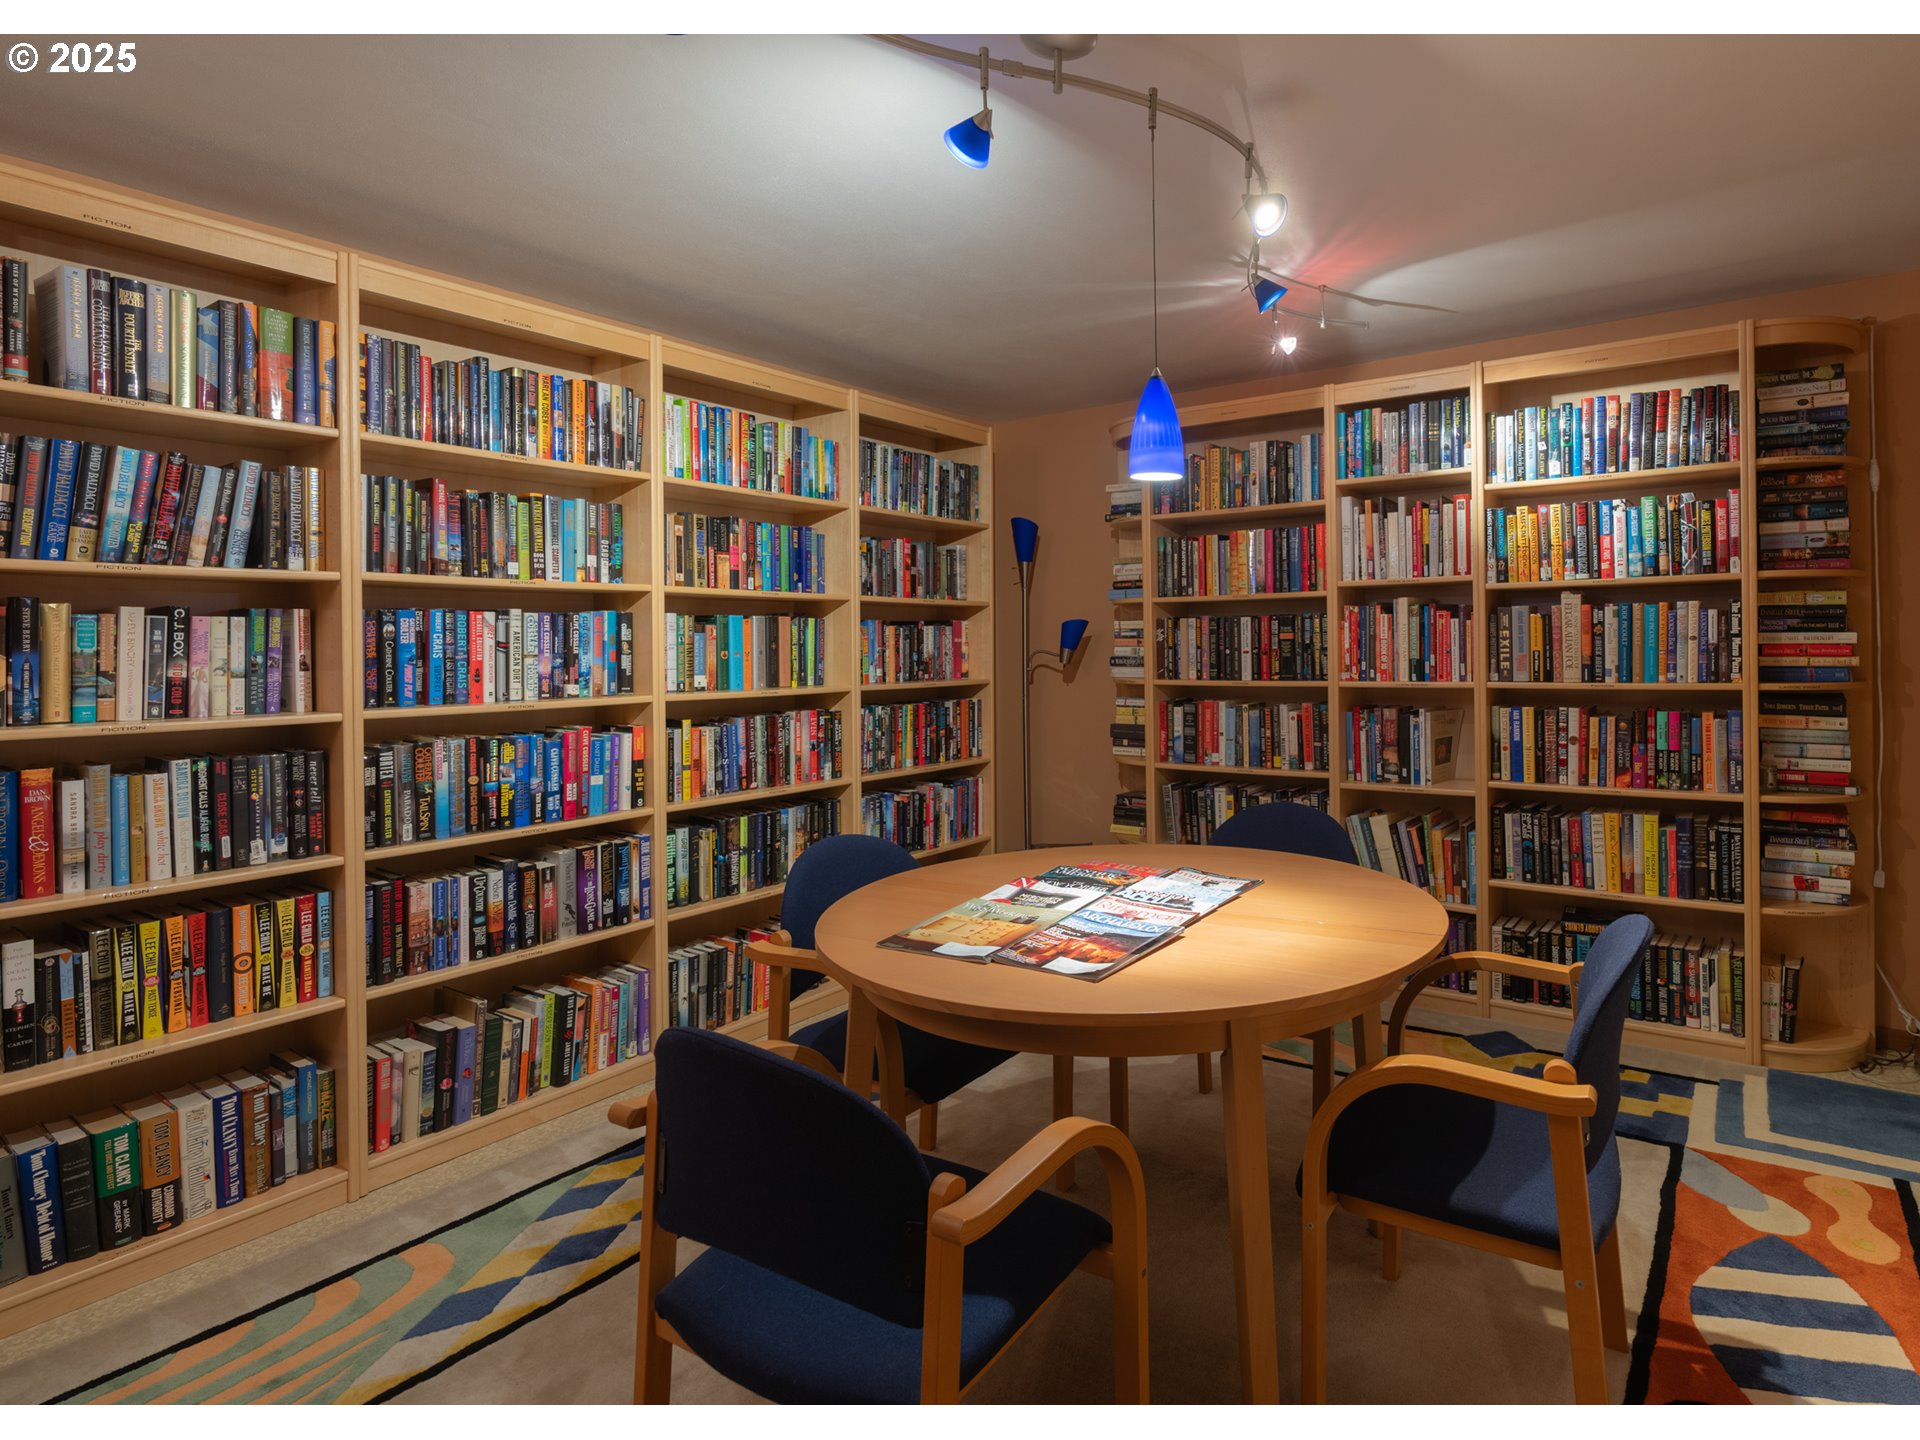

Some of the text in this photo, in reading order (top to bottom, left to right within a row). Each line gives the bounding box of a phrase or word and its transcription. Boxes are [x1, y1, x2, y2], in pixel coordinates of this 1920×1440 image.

[83, 213, 132, 230] FICTION
[123, 311, 136, 375] FOURTH ESTATE
[100, 396, 145, 407] FICTION
[541, 375, 552, 425] HARLAN COBEN
[6, 451, 17, 476] DAVID
[51, 441, 76, 518] DAVID BALDACCI
[83, 445, 103, 511] DAVID BALDACCI
[19, 449, 41, 546] DAVID BALDACCI REDEMPTION
[154, 462, 183, 541] DAVID BALDACCI
[240, 464, 258, 517] DAVID BALDACCI
[289, 478, 302, 542] DAVID BALDACCI
[46, 521, 58, 543] GAME
[56, 523, 68, 543] HOUR
[230, 527, 244, 556] GENIUS
[1644, 499, 1655, 554] JAMES PATTERSON
[1731, 601, 1741, 614] The
[21, 606, 31, 652] STEVE BERRY
[432, 633, 444, 660] CRAIS
[543, 614, 551, 658] CLIVE CUSSLER
[572, 613, 580, 655] CLIVE CUSSLER
[1499, 629, 1510, 670] EXILE
[1564, 602, 1575, 671] EDGAR ALLAN POE
[384, 640, 395, 693] CATHERINE COULTER
[457, 613, 467, 689] ROBERT CRAIS
[512, 630, 522, 685] AMERICAN DIRT
[170, 663, 183, 704] STONE COLD
[1513, 709, 1521, 720] IAN
[250, 769, 258, 793] SISTER
[308, 760, 322, 804] never tell
[415, 747, 426, 784] COULTER
[24, 794, 51, 804] BROWN
[174, 761, 191, 820] SANDRA BROWN
[216, 792, 228, 817] CLOSE
[379, 749, 394, 839] VORTEX CATHERINE COULTER
[403, 789, 412, 826] PARADO
[69, 791, 79, 881] SANDRA BROWN LETHAL
[92, 768, 110, 875] SANDRA BROWN play dirty
[28, 805, 50, 884] ANGELS & DEMONS
[104, 889, 150, 899] FICTION
[281, 914, 293, 949] LEE CHILD
[301, 910, 314, 944] LEE CHILD
[320, 904, 331, 939] LEE CHILD
[191, 928, 205, 965] LEE CHILD
[260, 918, 272, 997] LEE CHILD MAKE ME
[120, 941, 136, 1028] LEE CHILD MAKE ME
[143, 936, 158, 1020] LEE CHILD PAST TENSE
[170, 932, 183, 1017] LEE CHILD PERSONAL
[7, 1038, 34, 1048] CARTER
[110, 1050, 155, 1064] FICTION
[221, 1095, 239, 1150] TOM CLANCY
[250, 1088, 270, 1147] Tom Clancy
[30, 1148, 47, 1172] Tom
[113, 1132, 132, 1188] TOM CLANCY
[152, 1119, 174, 1179] TOM CLANCY
[29, 1169, 50, 1201] Clancy
[162, 1184, 176, 1219] COMMAND
[35, 1199, 54, 1225] Debt
[150, 1188, 164, 1225] AUTHORITY
[39, 1230, 56, 1262] Honor
